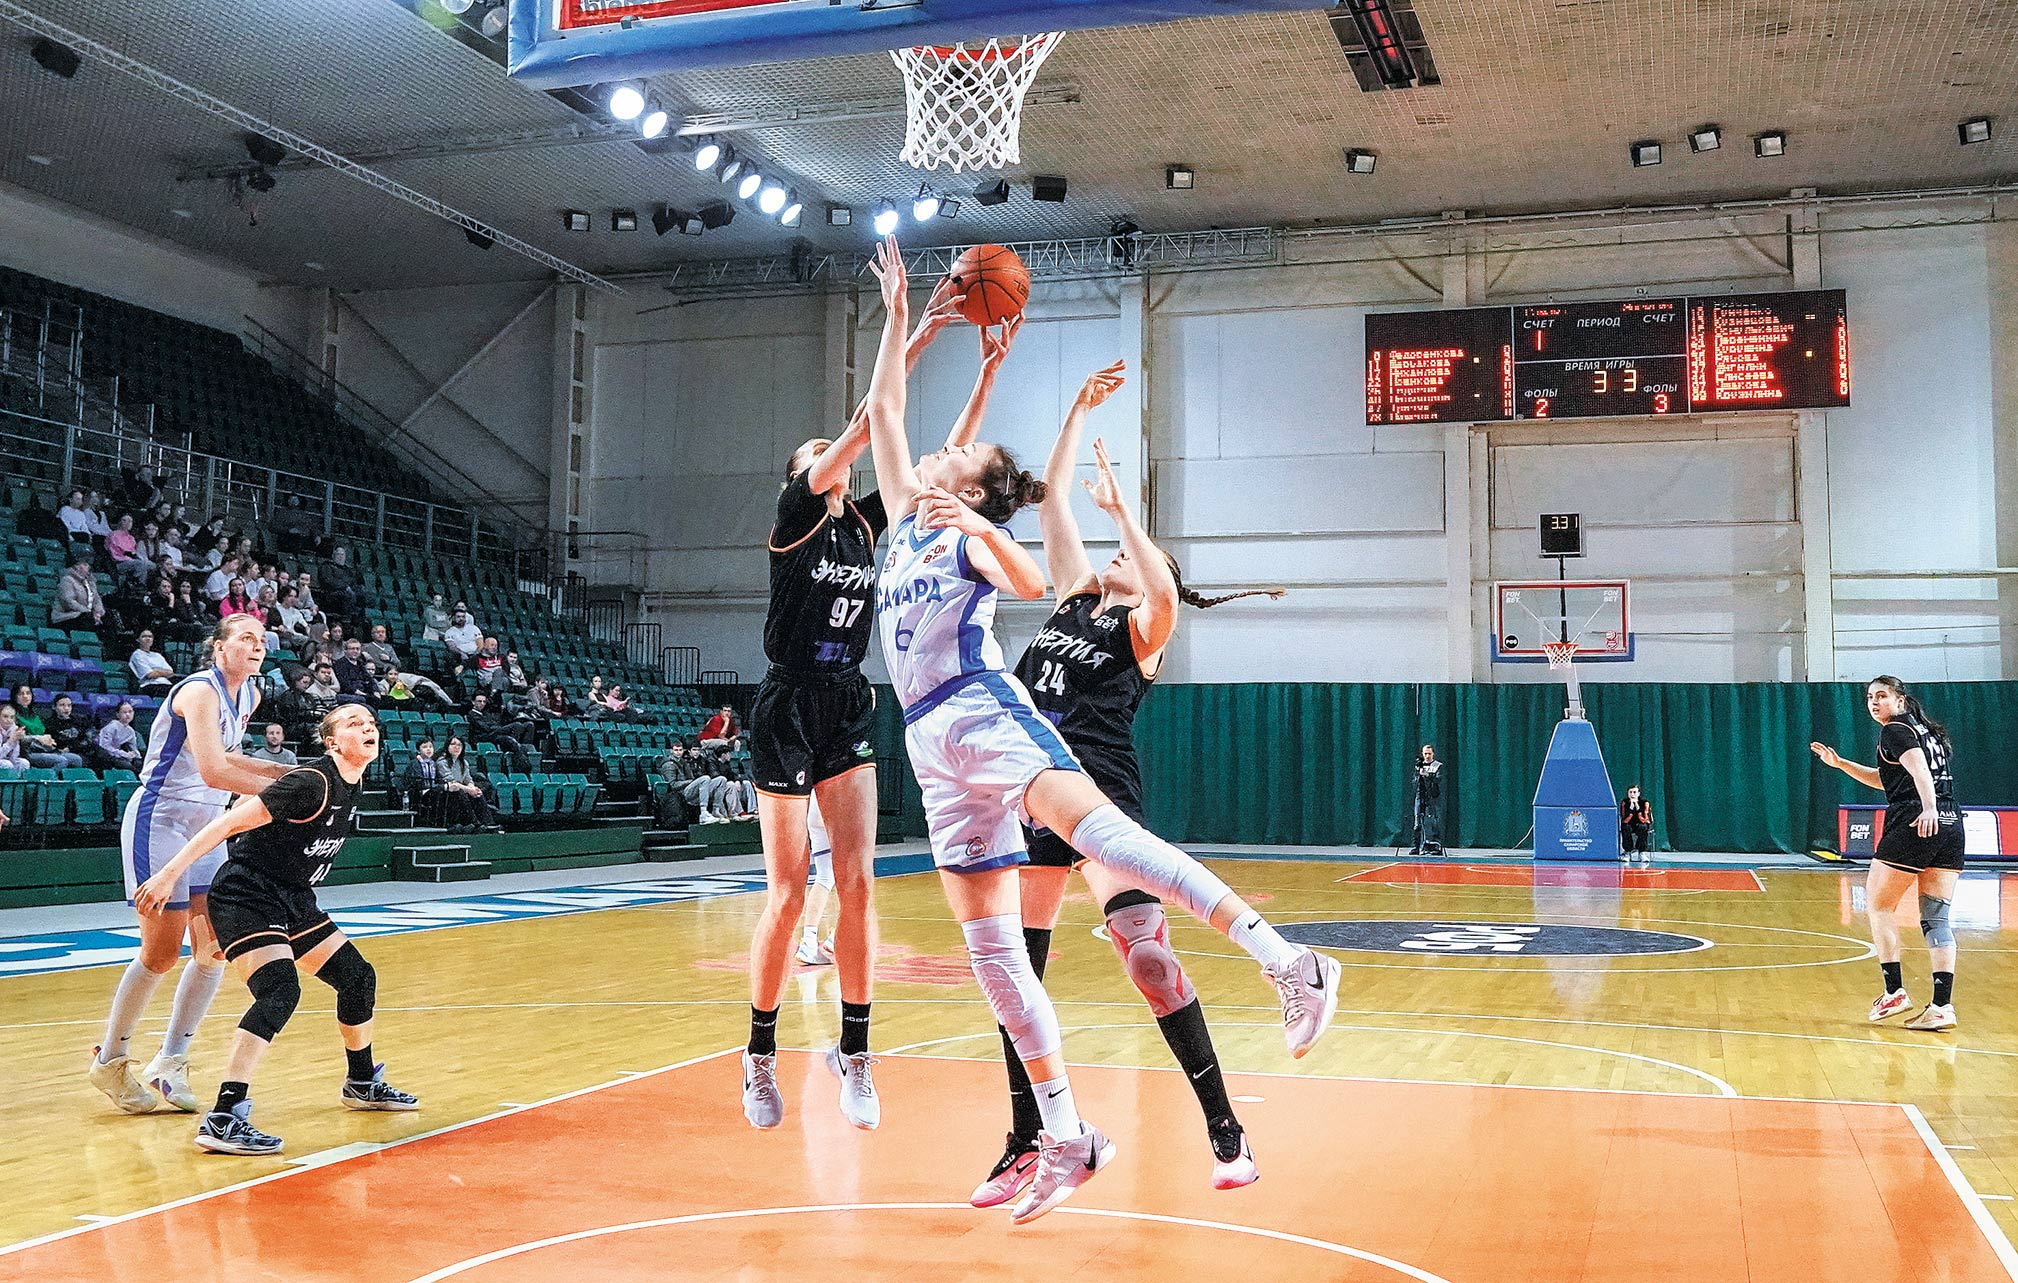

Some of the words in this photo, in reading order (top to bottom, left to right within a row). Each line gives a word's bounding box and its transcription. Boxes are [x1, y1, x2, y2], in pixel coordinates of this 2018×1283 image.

[1523, 319, 1555, 329] СЧЕТ
[1576, 317, 1621, 328] ПЕРИОД
[1643, 313, 1675, 323] СЧЕТ
[1565, 361, 1600, 371] ВРЕМЯ
[1606, 360, 1635, 370] ИГРЫ
[1524, 388, 1558, 398] ФОЛЫ
[1643, 384, 1678, 393] ФОЛЫ
[1536, 399, 1548, 417] 2
[1655, 394, 1668, 413] 3
[829, 597, 865, 628] 97
[895, 616, 910, 651] 6
[1034, 659, 1065, 696] 24
[1850, 824, 1870, 832] FON
[1851, 832, 1870, 840] BET
